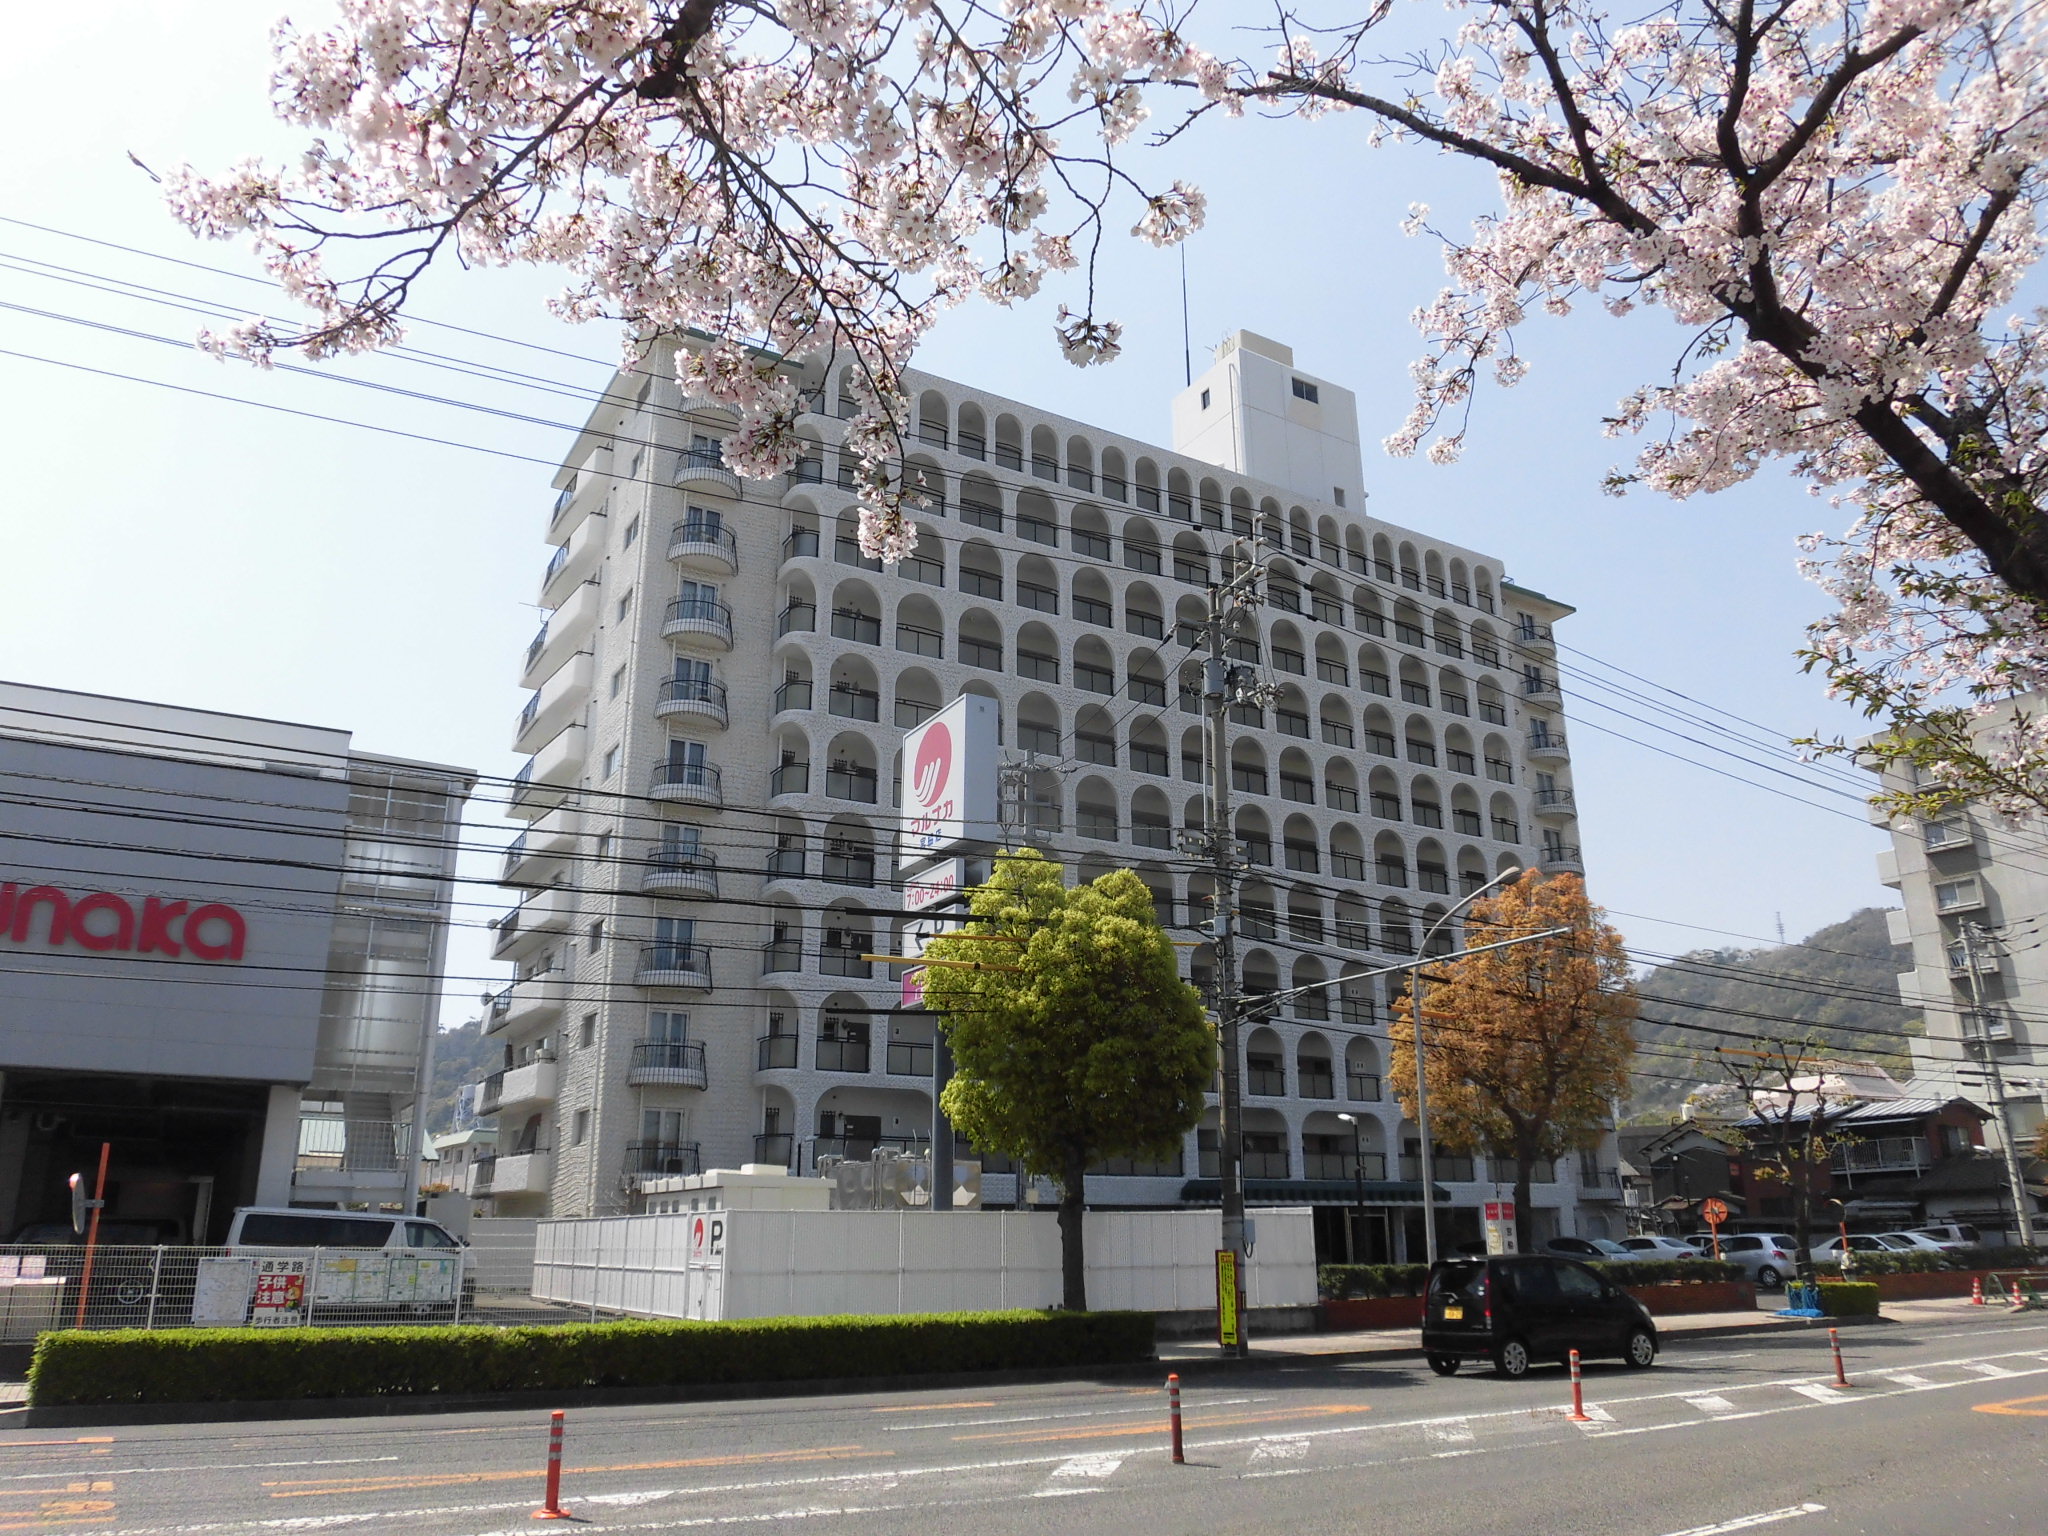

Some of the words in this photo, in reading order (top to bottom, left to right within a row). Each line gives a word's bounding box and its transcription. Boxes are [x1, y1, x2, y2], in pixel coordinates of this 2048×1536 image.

[710, 1220, 723, 1255] P
[262, 1261, 304, 1272] 通学路
[259, 1276, 287, 1289] 子供
[256, 1291, 285, 1304] 注意
